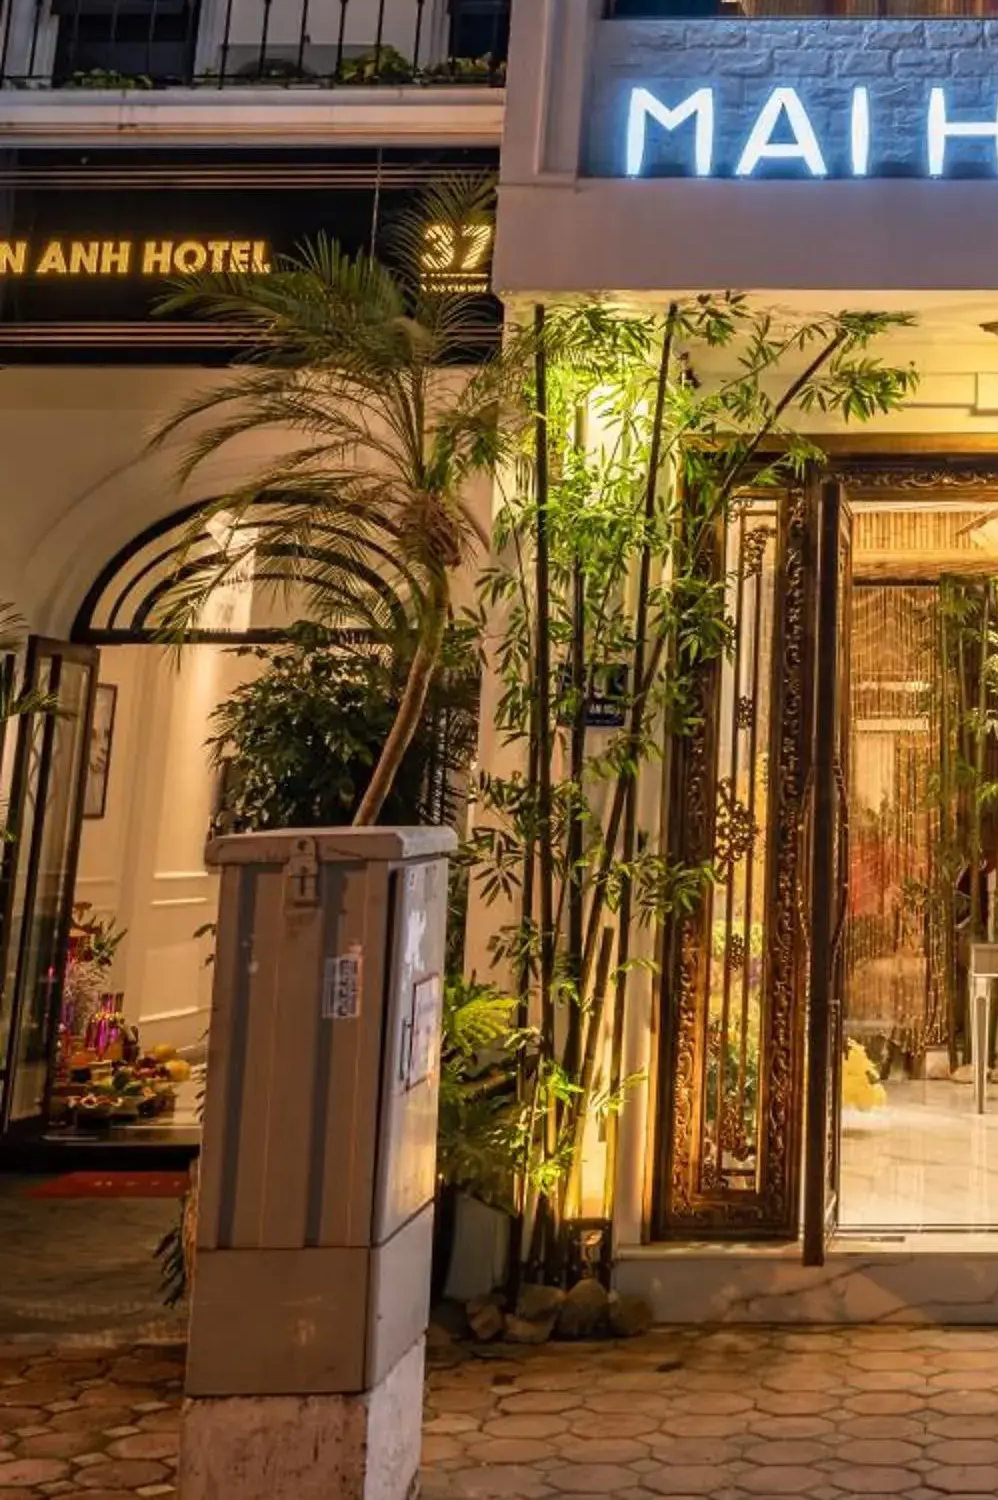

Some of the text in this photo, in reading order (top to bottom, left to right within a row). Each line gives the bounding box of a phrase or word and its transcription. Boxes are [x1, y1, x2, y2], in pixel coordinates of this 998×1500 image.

[625, 85, 869, 176] MAI
[36, 241, 128, 274] ANH
[142, 241, 271, 275] HOTEL
